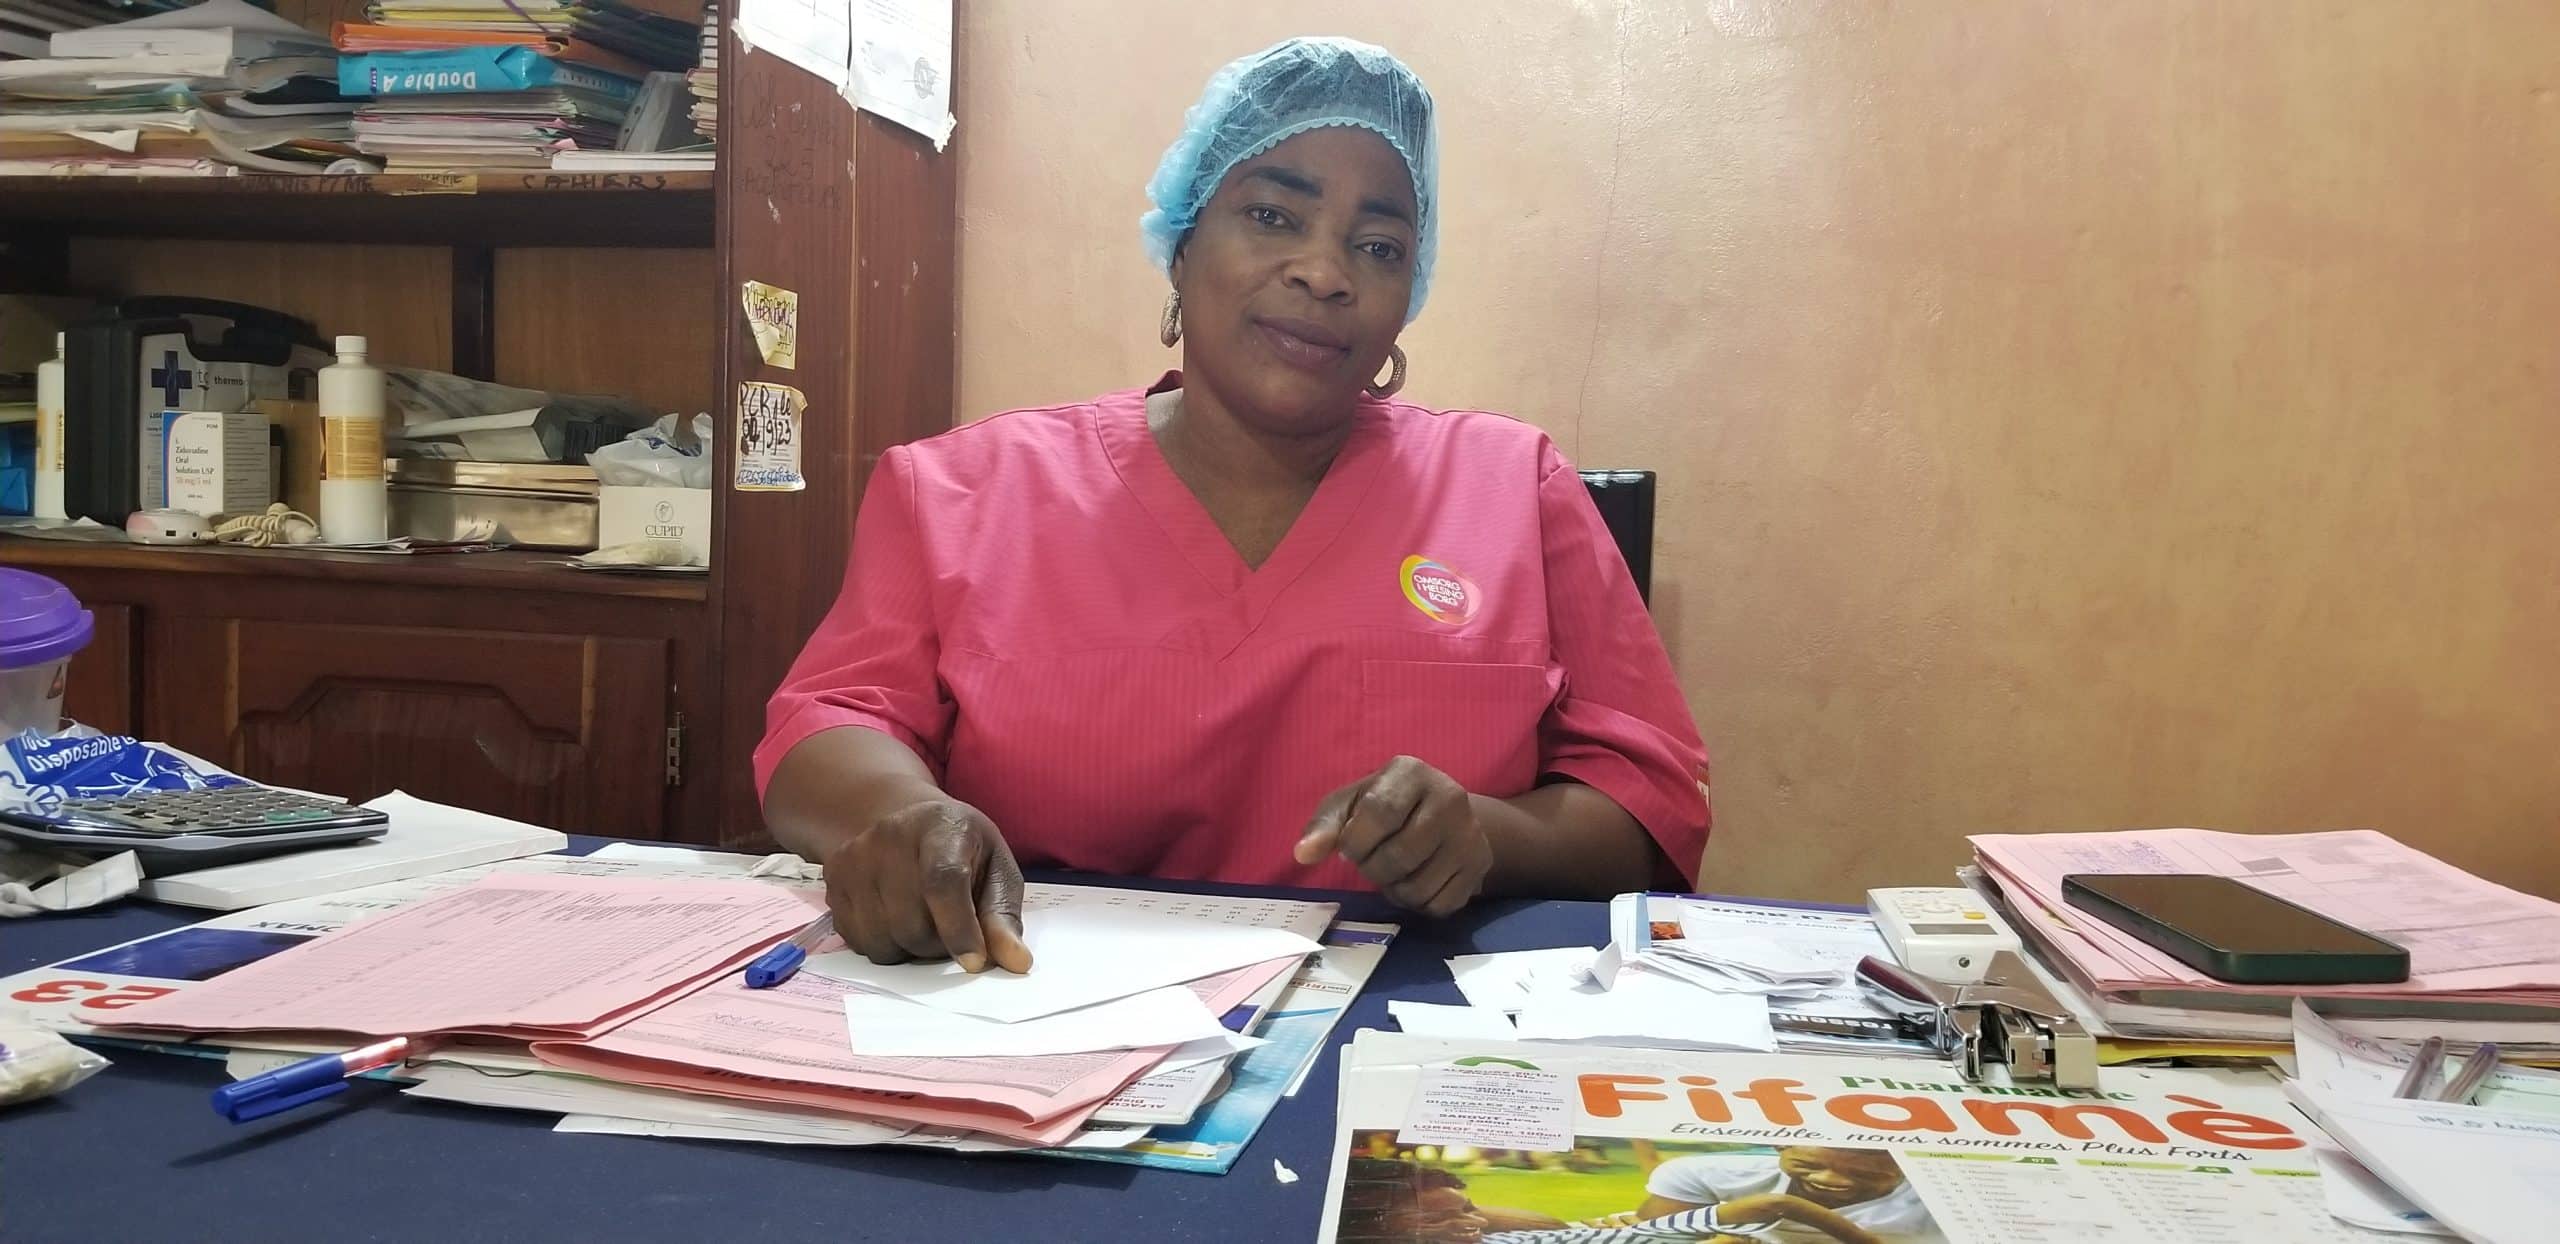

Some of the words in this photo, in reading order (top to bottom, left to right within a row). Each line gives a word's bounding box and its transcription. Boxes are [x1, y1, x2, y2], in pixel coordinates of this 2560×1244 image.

[382, 74, 398, 94] A
[403, 71, 476, 92] Double
[522, 174, 667, 190] CAHIERS
[214, 375, 245, 386] thermo
[739, 382, 771, 418] PCR
[645, 525, 683, 537] CUPID
[26, 736, 122, 773] Disposable
[10, 980, 182, 1010] 23
[1839, 1076, 2137, 1101] Pharmacie
[1577, 1073, 2307, 1151] Fifamè
[1846, 1132, 1928, 1144] nous
[1937, 1135, 2073, 1151] sommes
[2082, 1141, 2159, 1156] Plus
[2167, 1147, 2255, 1161] Forts
